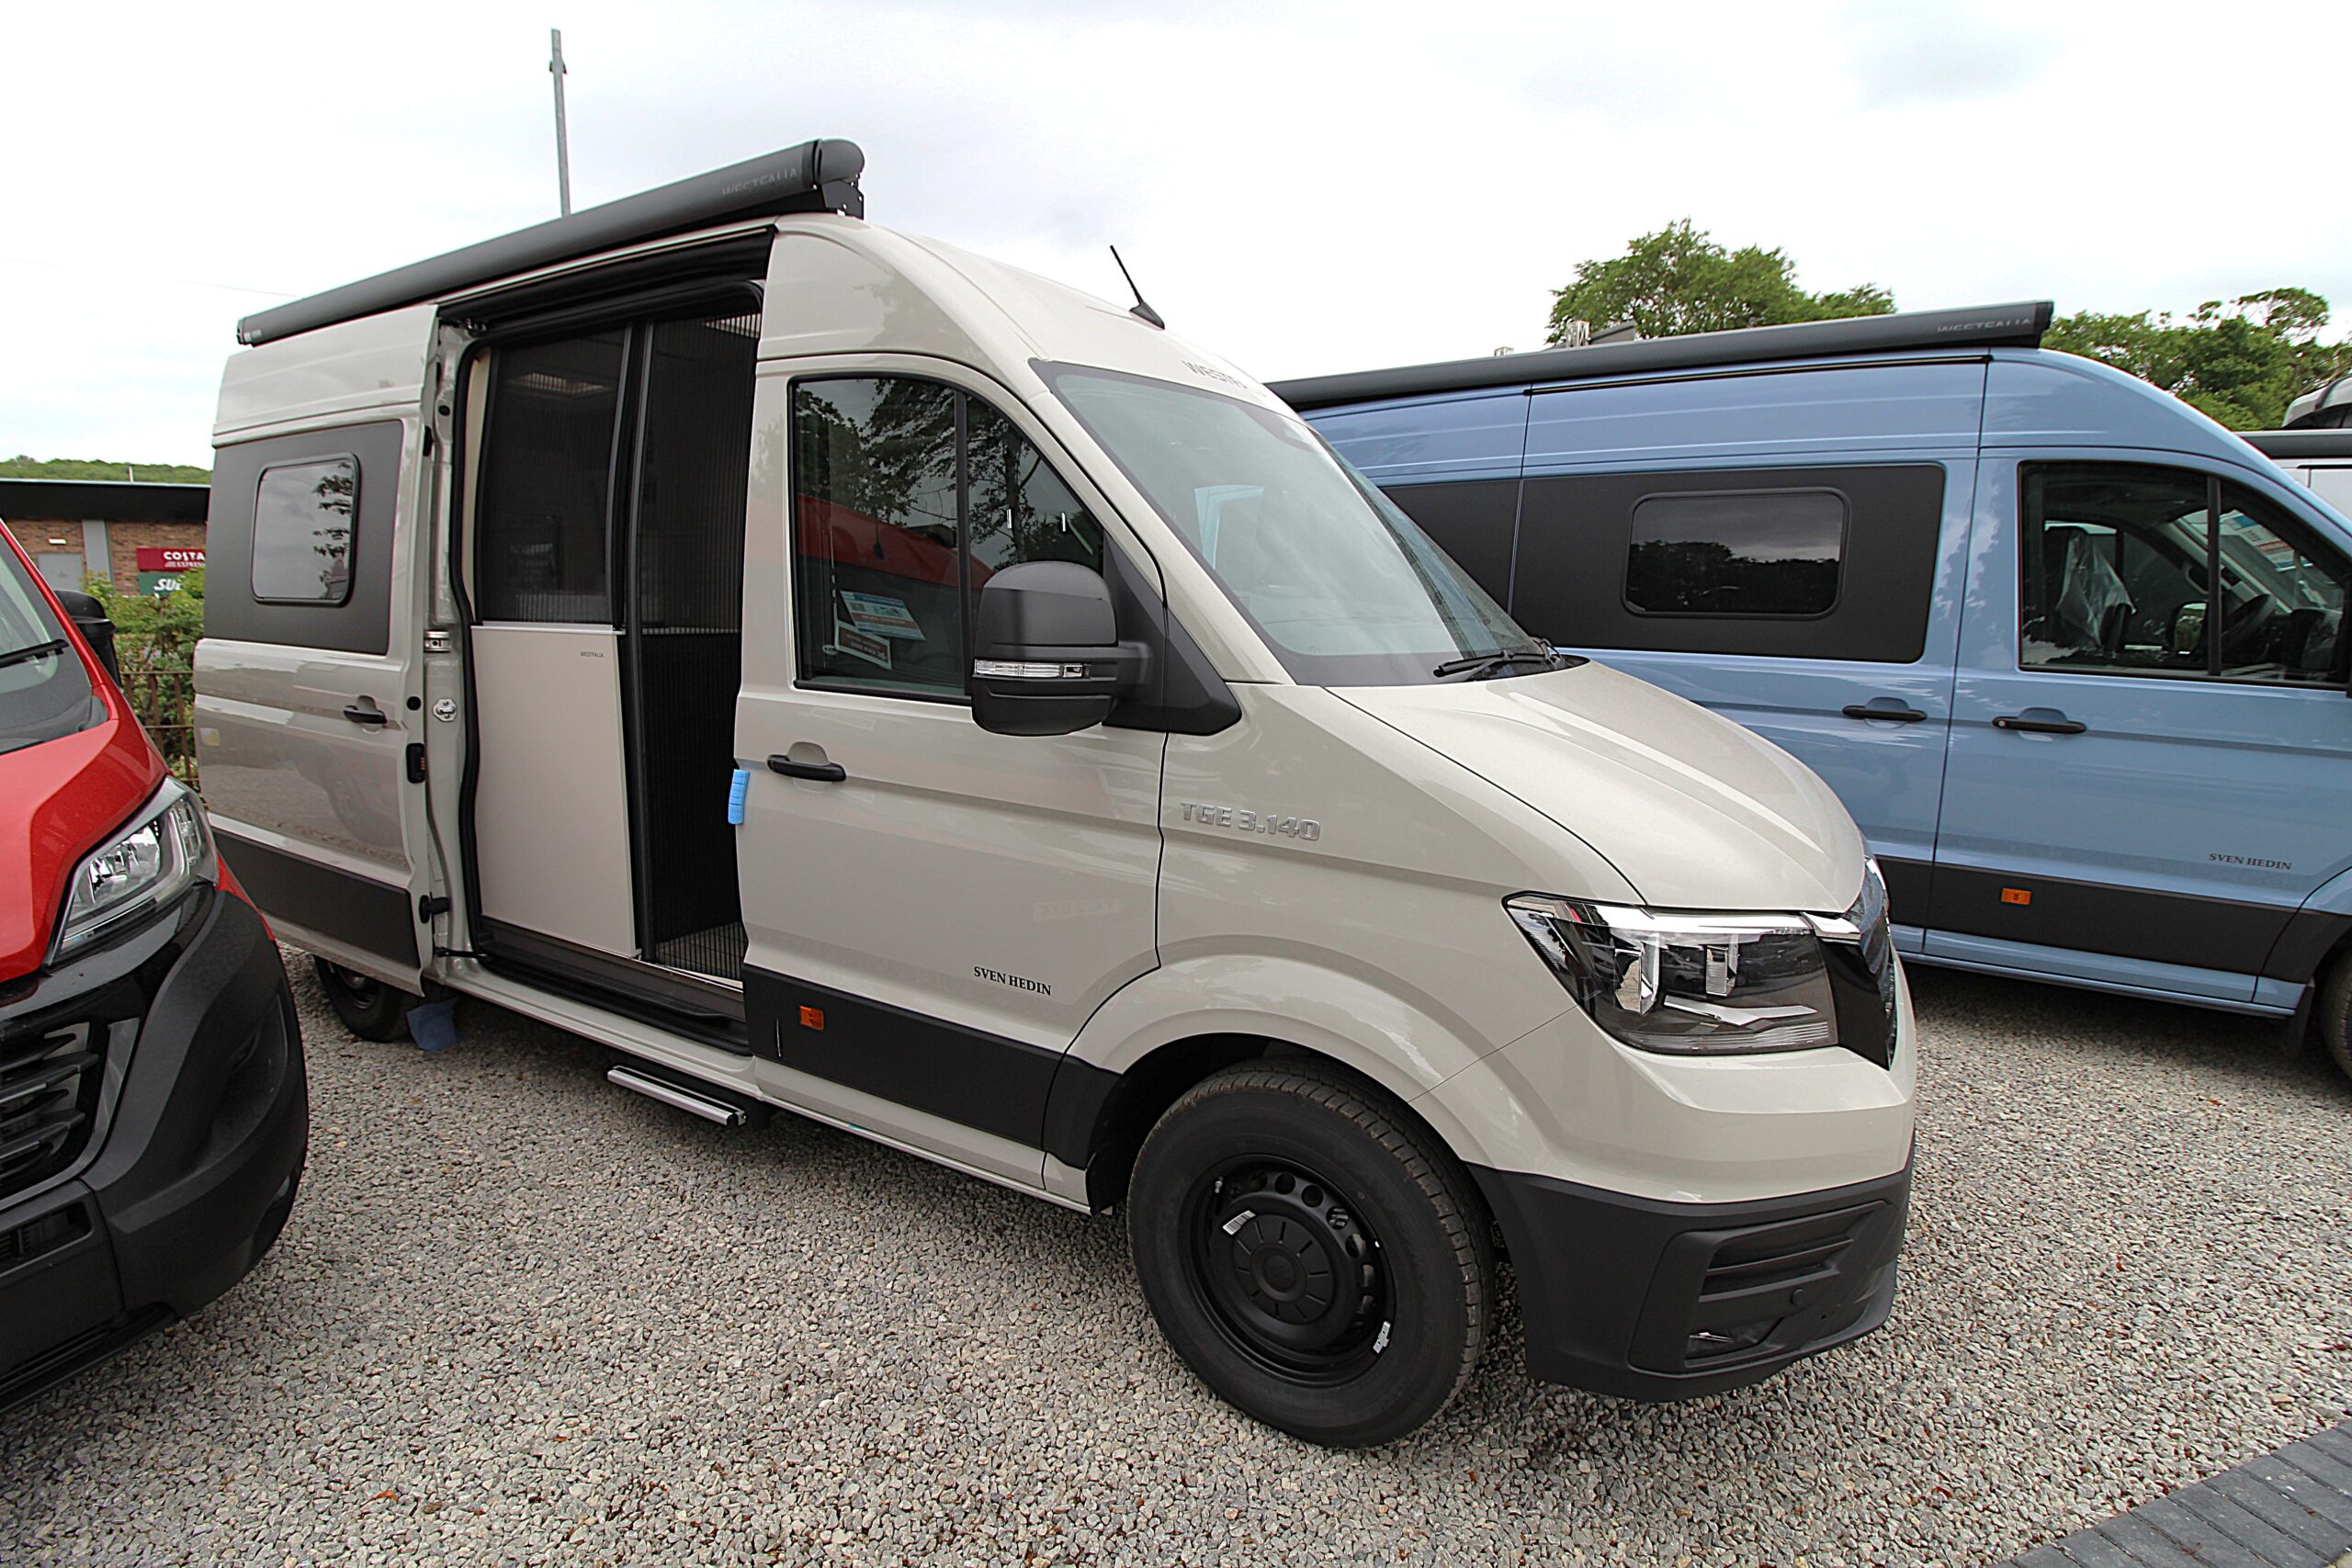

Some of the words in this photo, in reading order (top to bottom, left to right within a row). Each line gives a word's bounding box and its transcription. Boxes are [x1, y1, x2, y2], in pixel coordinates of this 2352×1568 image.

[163, 551, 206, 561] COSTA
[1181, 800, 1232, 828] TGE
[1238, 809, 1321, 841] 3.140
[2209, 852, 2245, 865] SVEN
[2245, 857, 2292, 871] HEDIN
[974, 965, 1006, 985] SVEN
[1008, 975, 1052, 997] HEDIN
